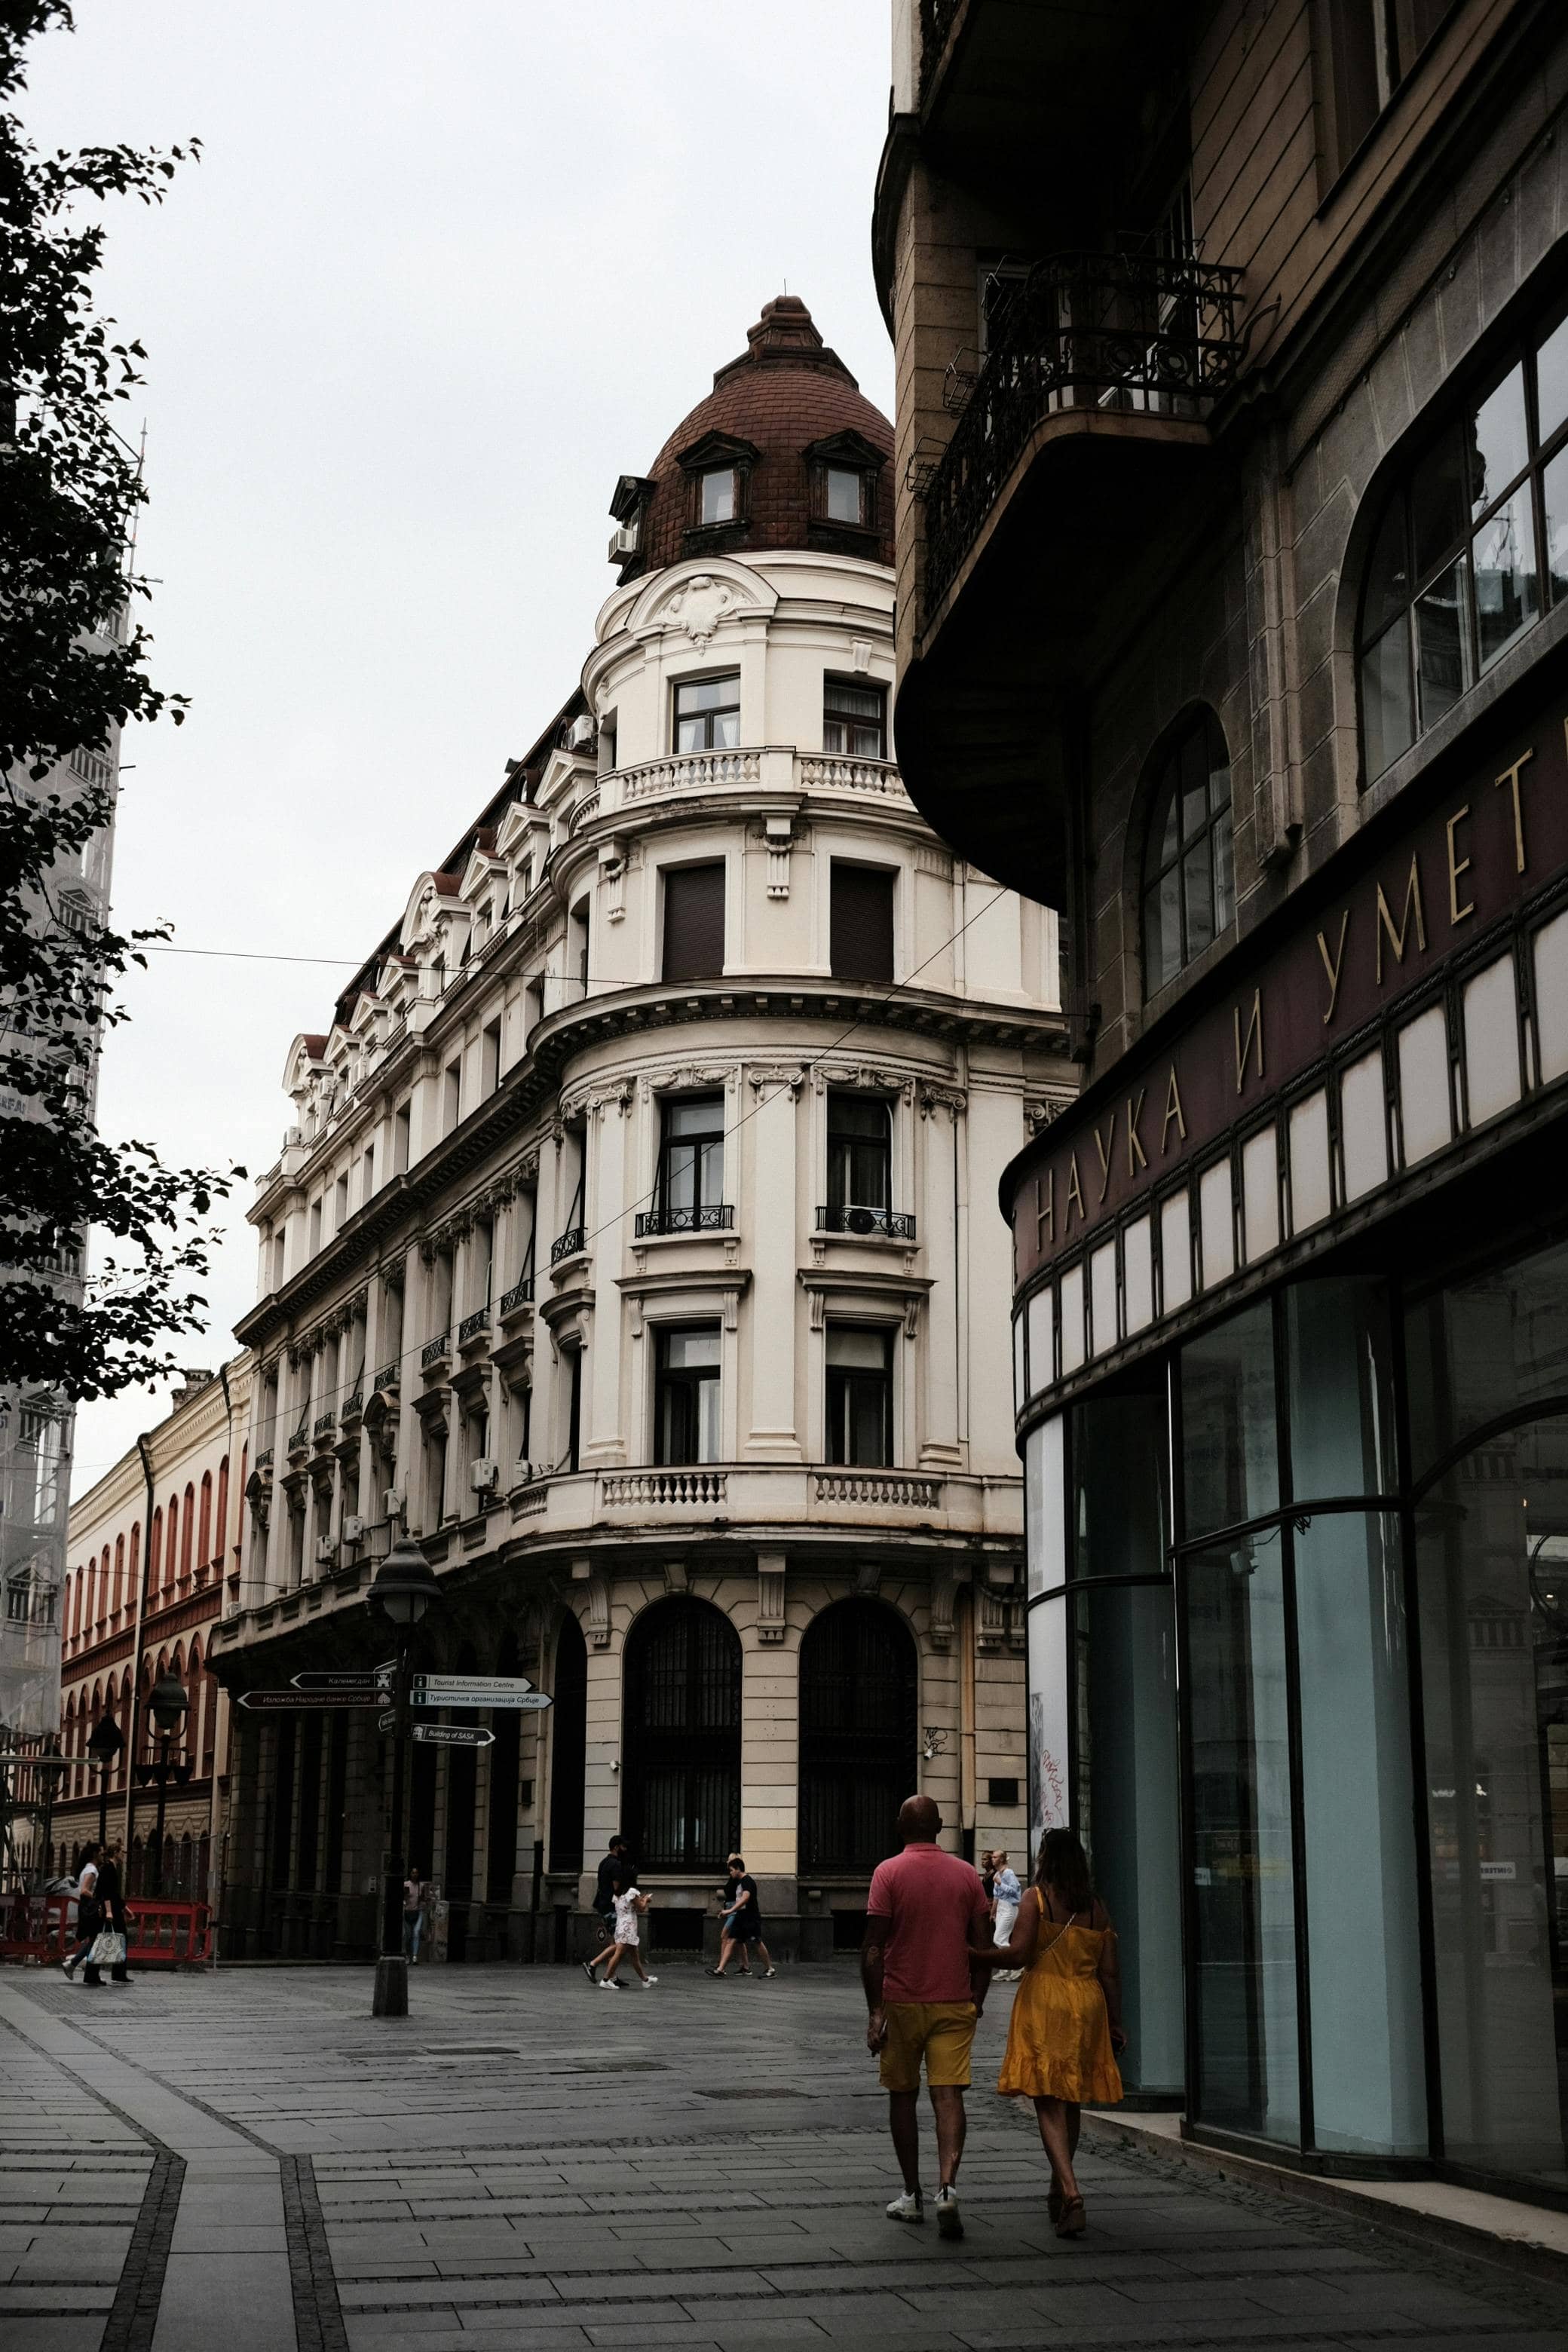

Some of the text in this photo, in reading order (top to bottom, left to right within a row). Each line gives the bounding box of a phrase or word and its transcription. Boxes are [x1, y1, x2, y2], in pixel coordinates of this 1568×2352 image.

[1035, 1064, 1187, 1251] НАУКА
[1234, 988, 1265, 1095] И
[1316, 716, 1568, 1024] УМЕТ
[456, 1679, 492, 1687] Information
[430, 1694, 540, 1704] Туристичка организација Србије
[428, 1730, 450, 1740] Building
